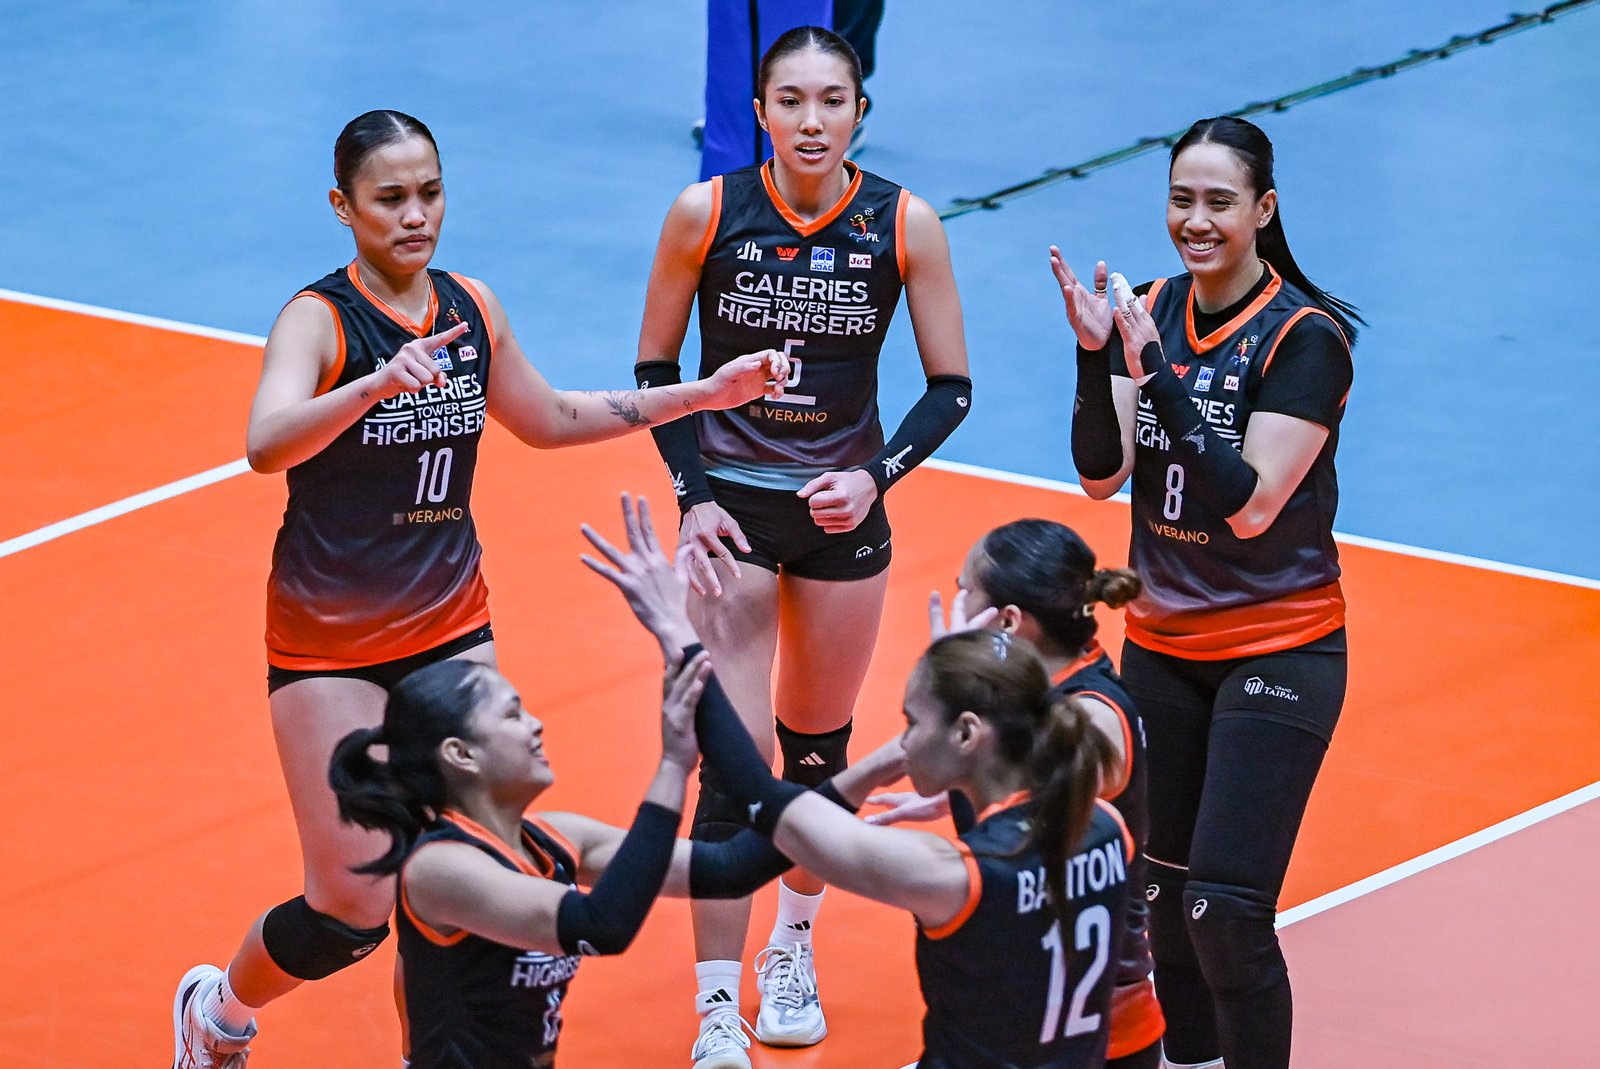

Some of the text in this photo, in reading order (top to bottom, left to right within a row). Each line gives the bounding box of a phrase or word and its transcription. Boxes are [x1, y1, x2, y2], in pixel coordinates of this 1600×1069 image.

[735, 271, 869, 303] GALERIES
[717, 298, 877, 336] HIGHRISERS
[773, 298, 827, 314] TOWER
[782, 339, 805, 388] 5
[415, 403, 461, 420] TOWER
[765, 407, 828, 423] VERANO
[415, 447, 454, 505] 10
[1163, 463, 1185, 521] 8
[407, 507, 463, 523] VERANO
[1154, 523, 1209, 545] VERANO
[1264, 686, 1299, 702] TAIPAN
[1017, 838, 1126, 915] BAITON
[1039, 904, 1111, 1045] 12
